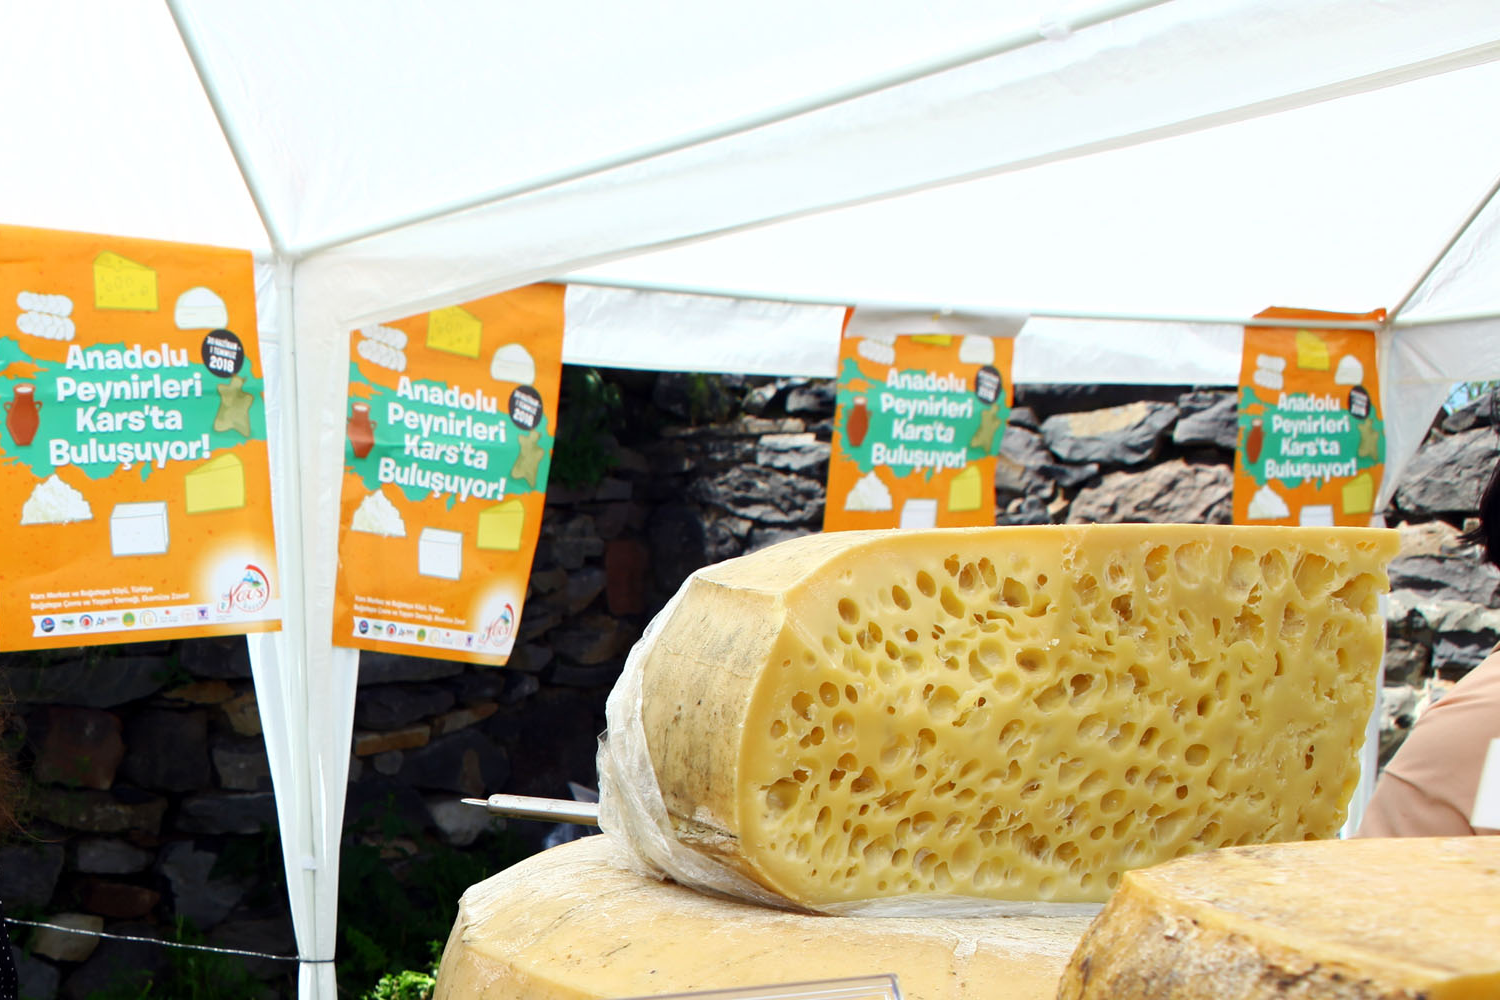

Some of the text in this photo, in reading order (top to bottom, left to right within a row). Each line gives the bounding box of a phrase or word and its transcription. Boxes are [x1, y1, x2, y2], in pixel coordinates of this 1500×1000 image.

[65, 343, 189, 371] Anadolu
[209, 354, 235, 374] 2018
[56, 372, 202, 408] Peynirleri
[396, 375, 497, 414] Anadolu
[886, 367, 966, 394] Anadolu
[880, 392, 974, 421] Peynirleri
[1277, 392, 1341, 412] Anadolu
[76, 404, 183, 433] Kars'ta
[388, 401, 506, 443] Peynirleri
[892, 418, 956, 443] Kars'ta
[1272, 415, 1350, 438] Peynirleri
[49, 434, 211, 471] Buluşuyor!
[404, 433, 488, 470] Kars'ta
[871, 443, 967, 474] Buluşuyor!
[1280, 437, 1340, 456] Kars'ta
[378, 457, 507, 502] Buluşuyor!
[1264, 458, 1357, 484] Buluşuyor!
